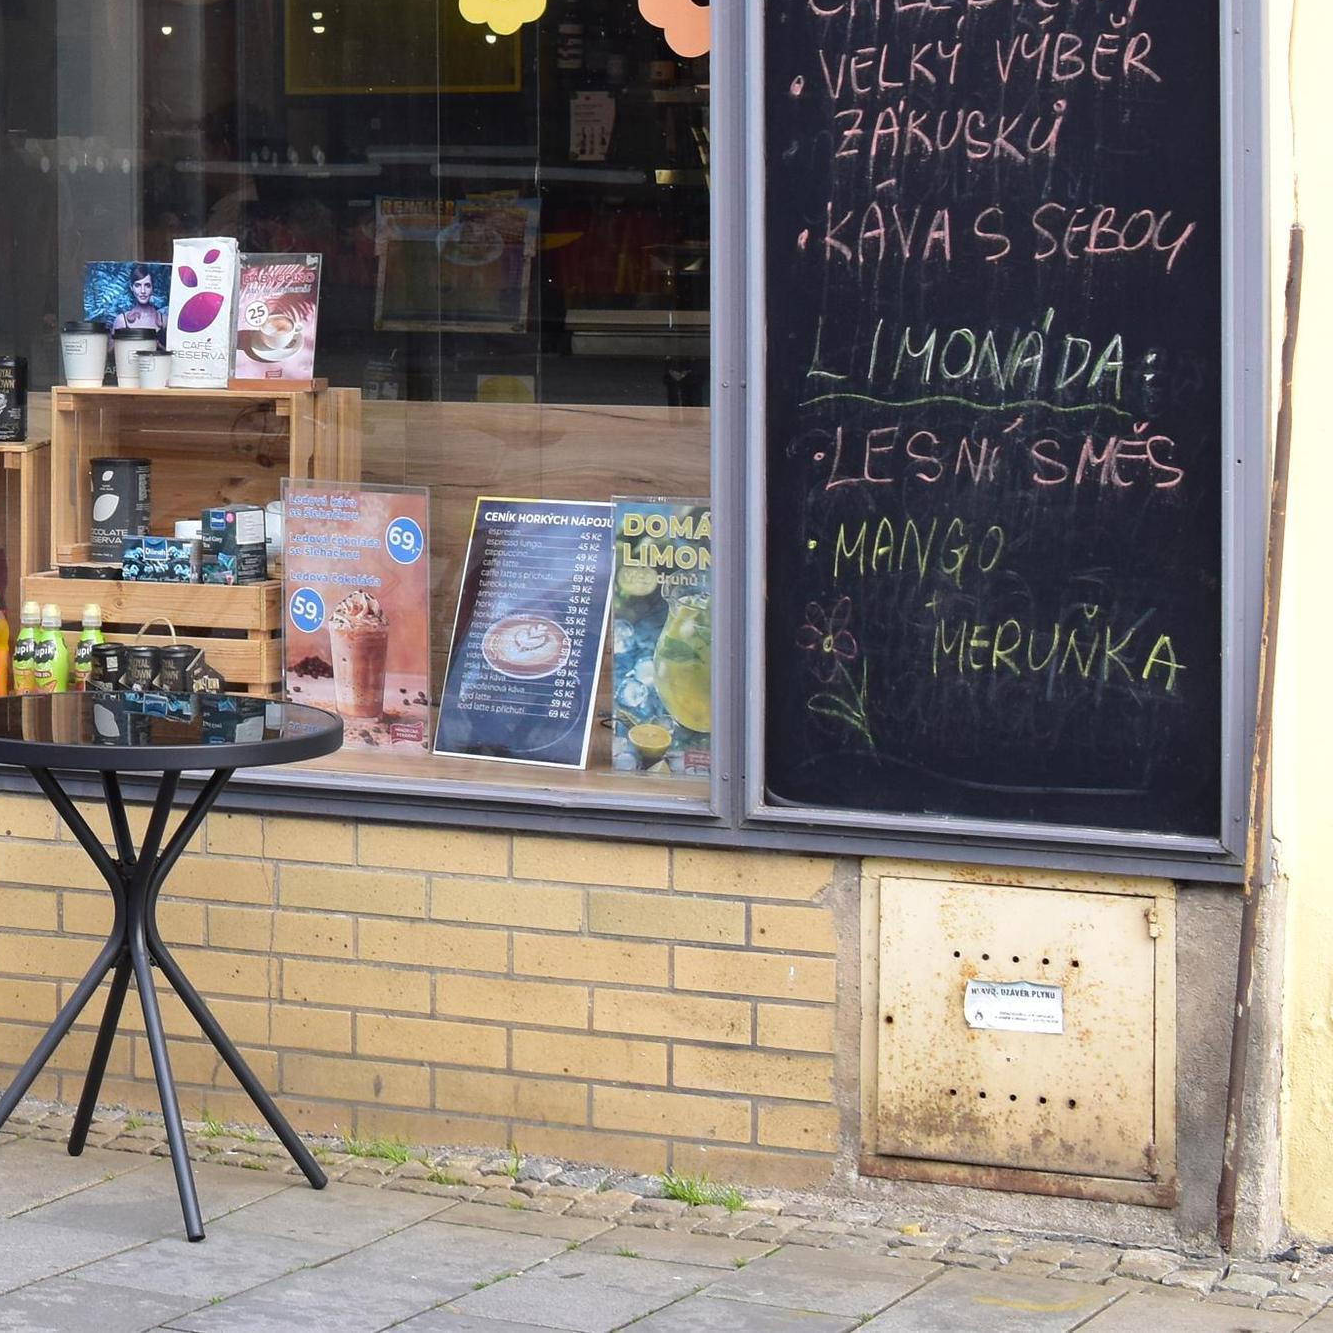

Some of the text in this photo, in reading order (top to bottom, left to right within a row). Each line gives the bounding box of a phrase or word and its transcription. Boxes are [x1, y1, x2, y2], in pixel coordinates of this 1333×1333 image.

[819, 13, 1162, 99] VELKÝ VÝBĚR
[835, 99, 1067, 163] ZÁKUSKŮ
[823, 178, 952, 265] KÁVA
[973, 206, 1011, 261] S
[247, 305, 266, 320] 25
[171, 350, 226, 361] RESERVA
[182, 338, 212, 350] CAFÉ
[826, 417, 1185, 491] LESNÍ SMĚS
[484, 510, 516, 523] CENÍK
[517, 512, 569, 525] HORKÝCH
[488, 528, 521, 537] espresso
[486, 539, 519, 548] espresso
[833, 517, 1005, 589] MANGO
[934, 603, 1187, 694] MERUŇKA
